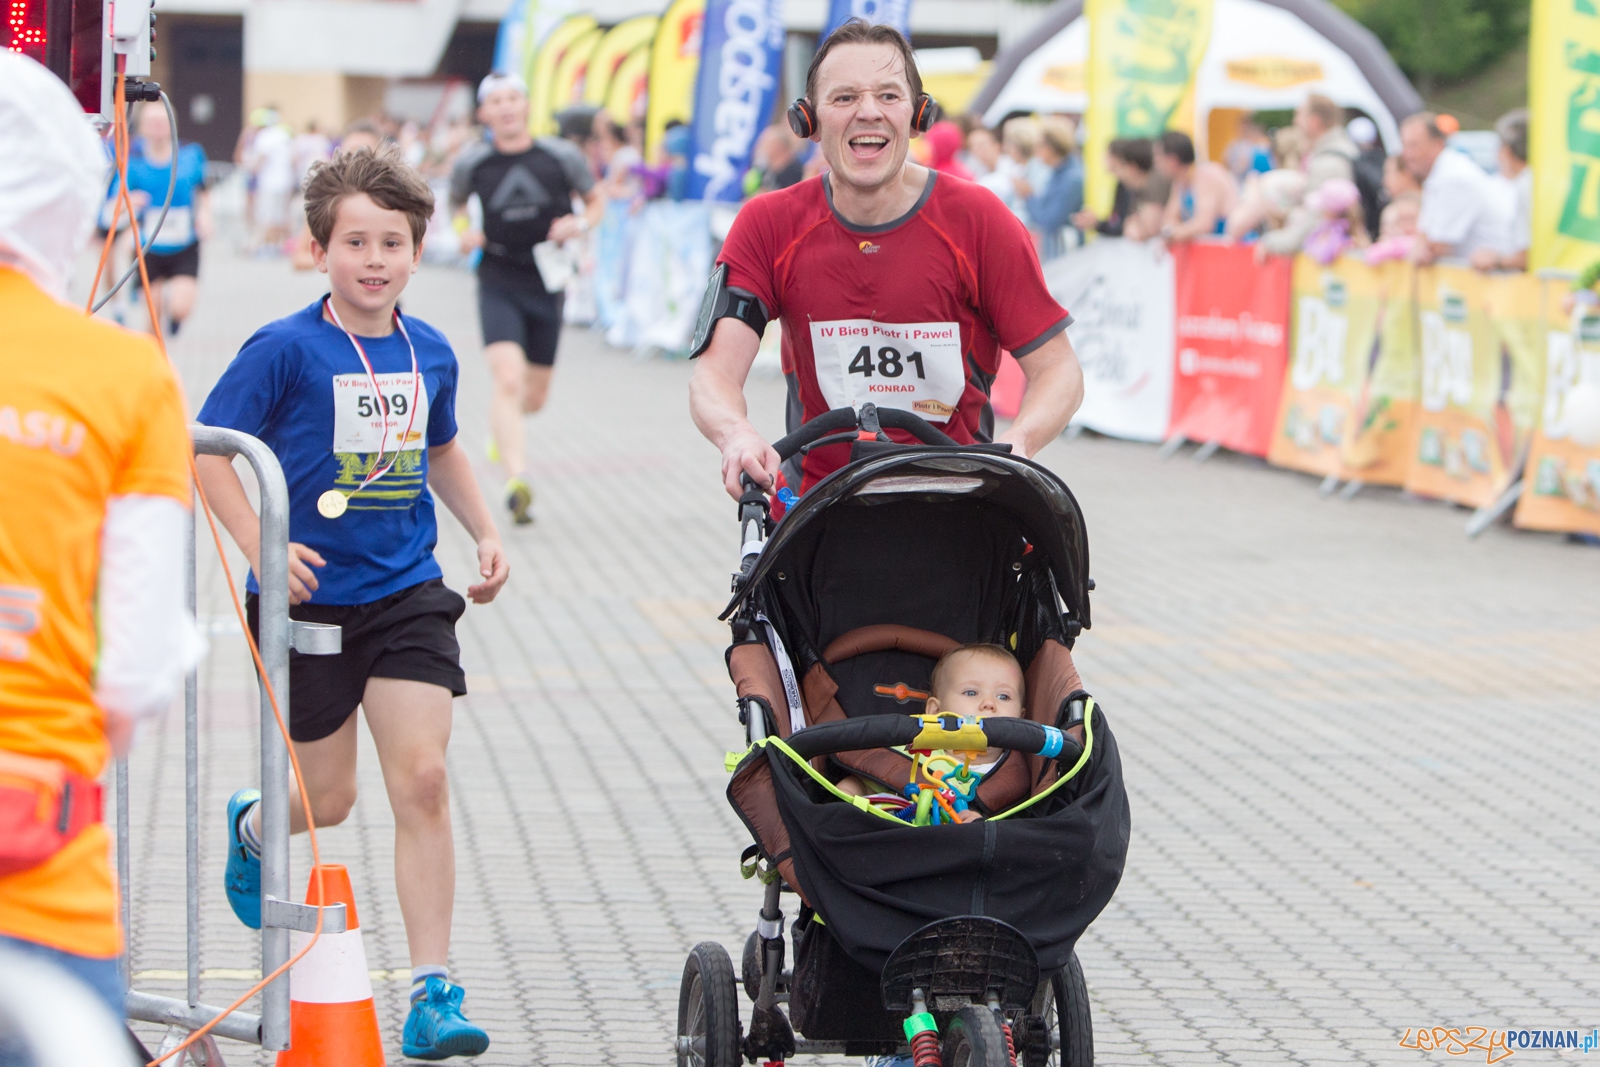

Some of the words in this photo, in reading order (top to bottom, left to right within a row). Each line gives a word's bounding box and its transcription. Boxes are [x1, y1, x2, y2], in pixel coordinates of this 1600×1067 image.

[820, 327, 834, 337] IV
[839, 326, 869, 337] Bieg
[872, 326, 901, 339] Piotr
[904, 329, 909, 340] i
[913, 328, 953, 340] Paweł
[848, 345, 926, 380] 481
[339, 380, 349, 388] IV
[351, 379, 368, 389] Bieg
[868, 384, 915, 393] KONRAD
[357, 393, 408, 418] 509
